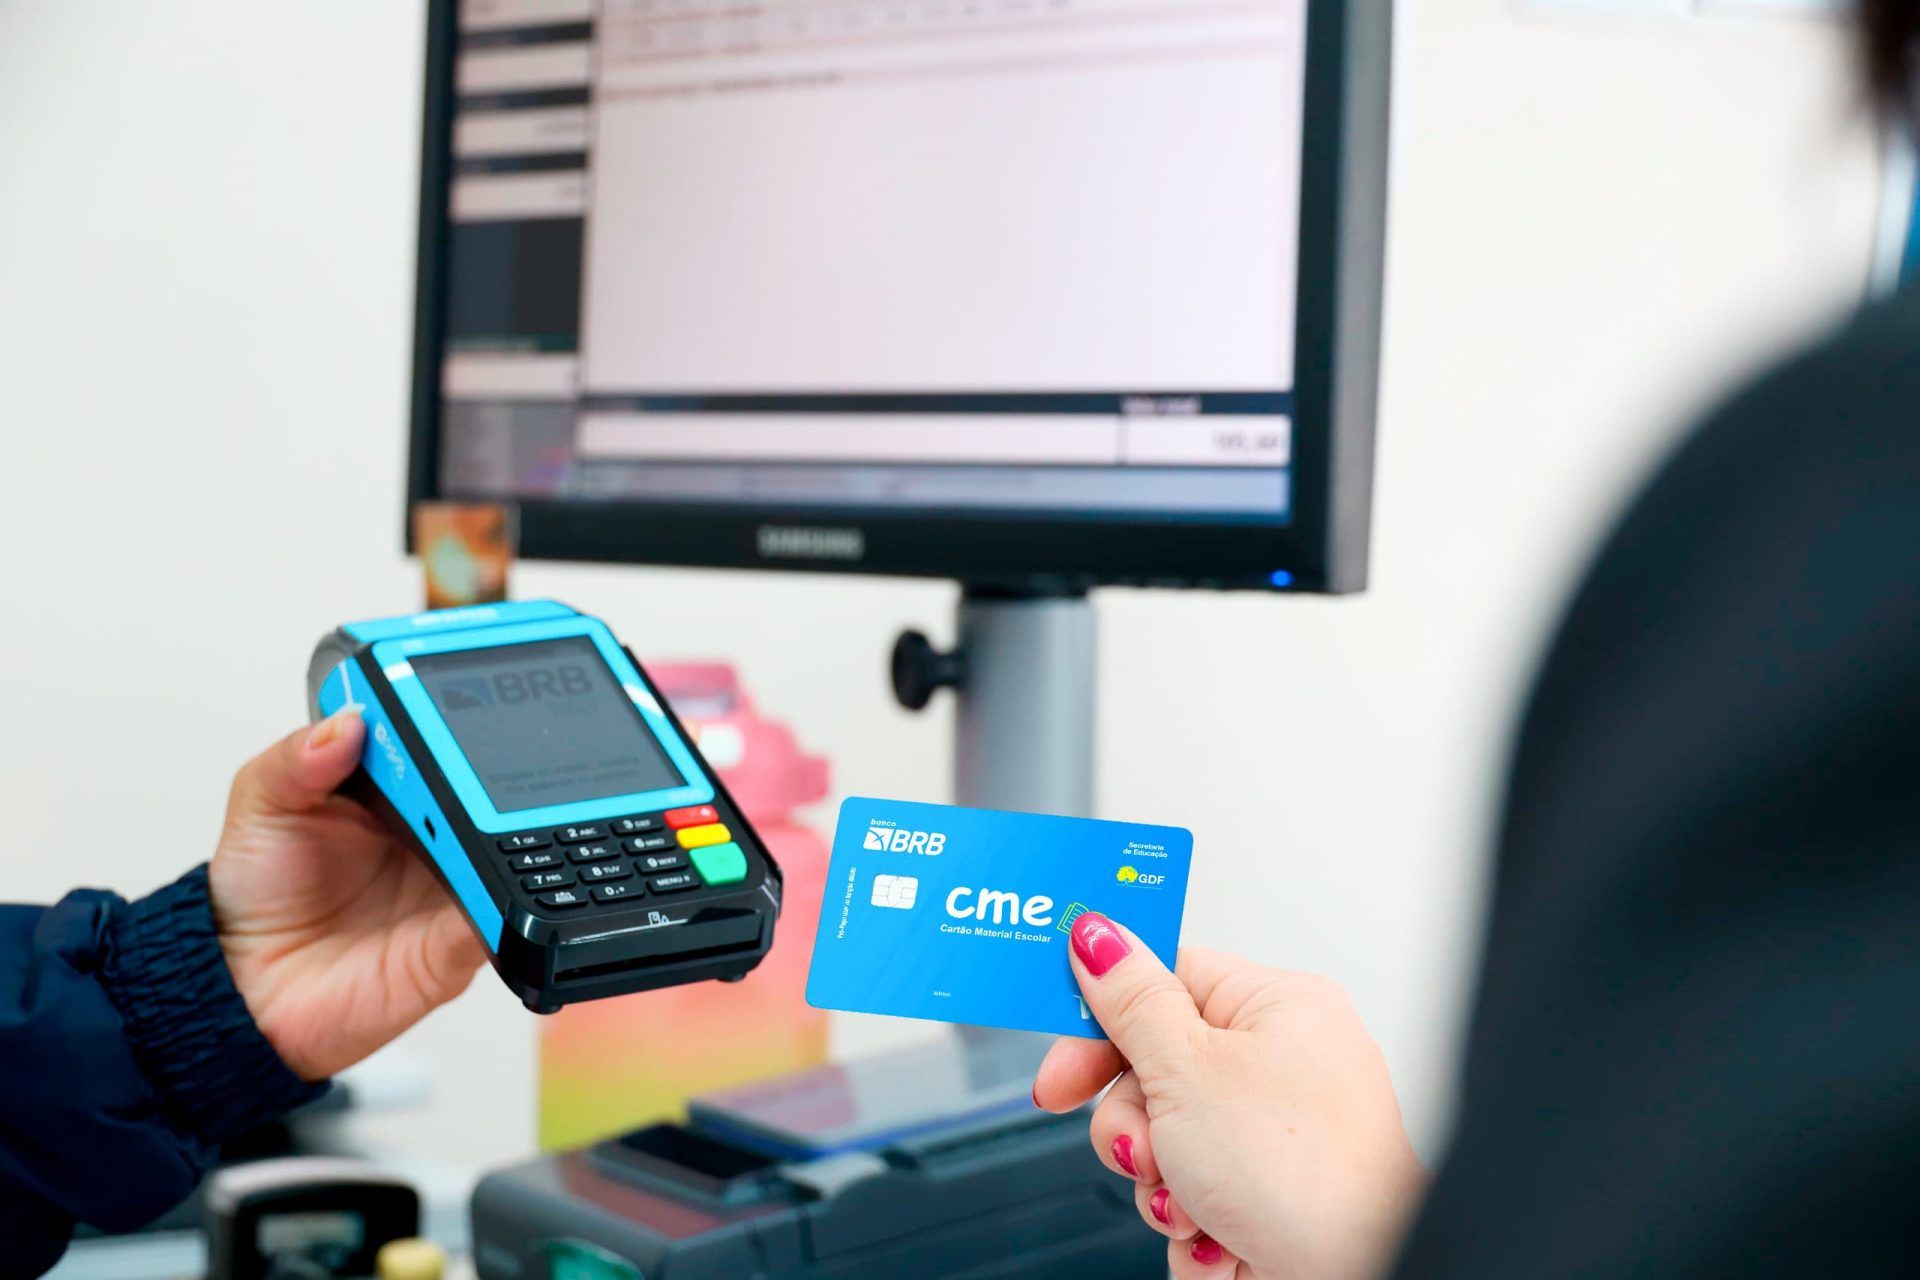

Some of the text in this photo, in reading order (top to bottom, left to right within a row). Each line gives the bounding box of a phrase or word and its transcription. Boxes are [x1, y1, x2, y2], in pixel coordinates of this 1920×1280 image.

[492, 664, 594, 705] BRB
[623, 819, 634, 830] 3
[870, 818, 897, 827] banco
[566, 827, 579, 838] 2
[512, 836, 521, 846] 1
[634, 838, 645, 848] 6
[890, 829, 947, 856] BRB
[1128, 841, 1164, 850] Secretaria
[579, 846, 590, 857] 5
[1133, 848, 1168, 858] Educação
[523, 855, 533, 865] 4
[647, 857, 658, 868] 9
[592, 865, 620, 877] 8 TUV
[534, 875, 543, 885] 7
[656, 876, 683, 886] MENU
[1138, 873, 1165, 884] GDF
[945, 886, 1054, 927] cme
[940, 923, 1053, 943] Cartão Material Escolar
